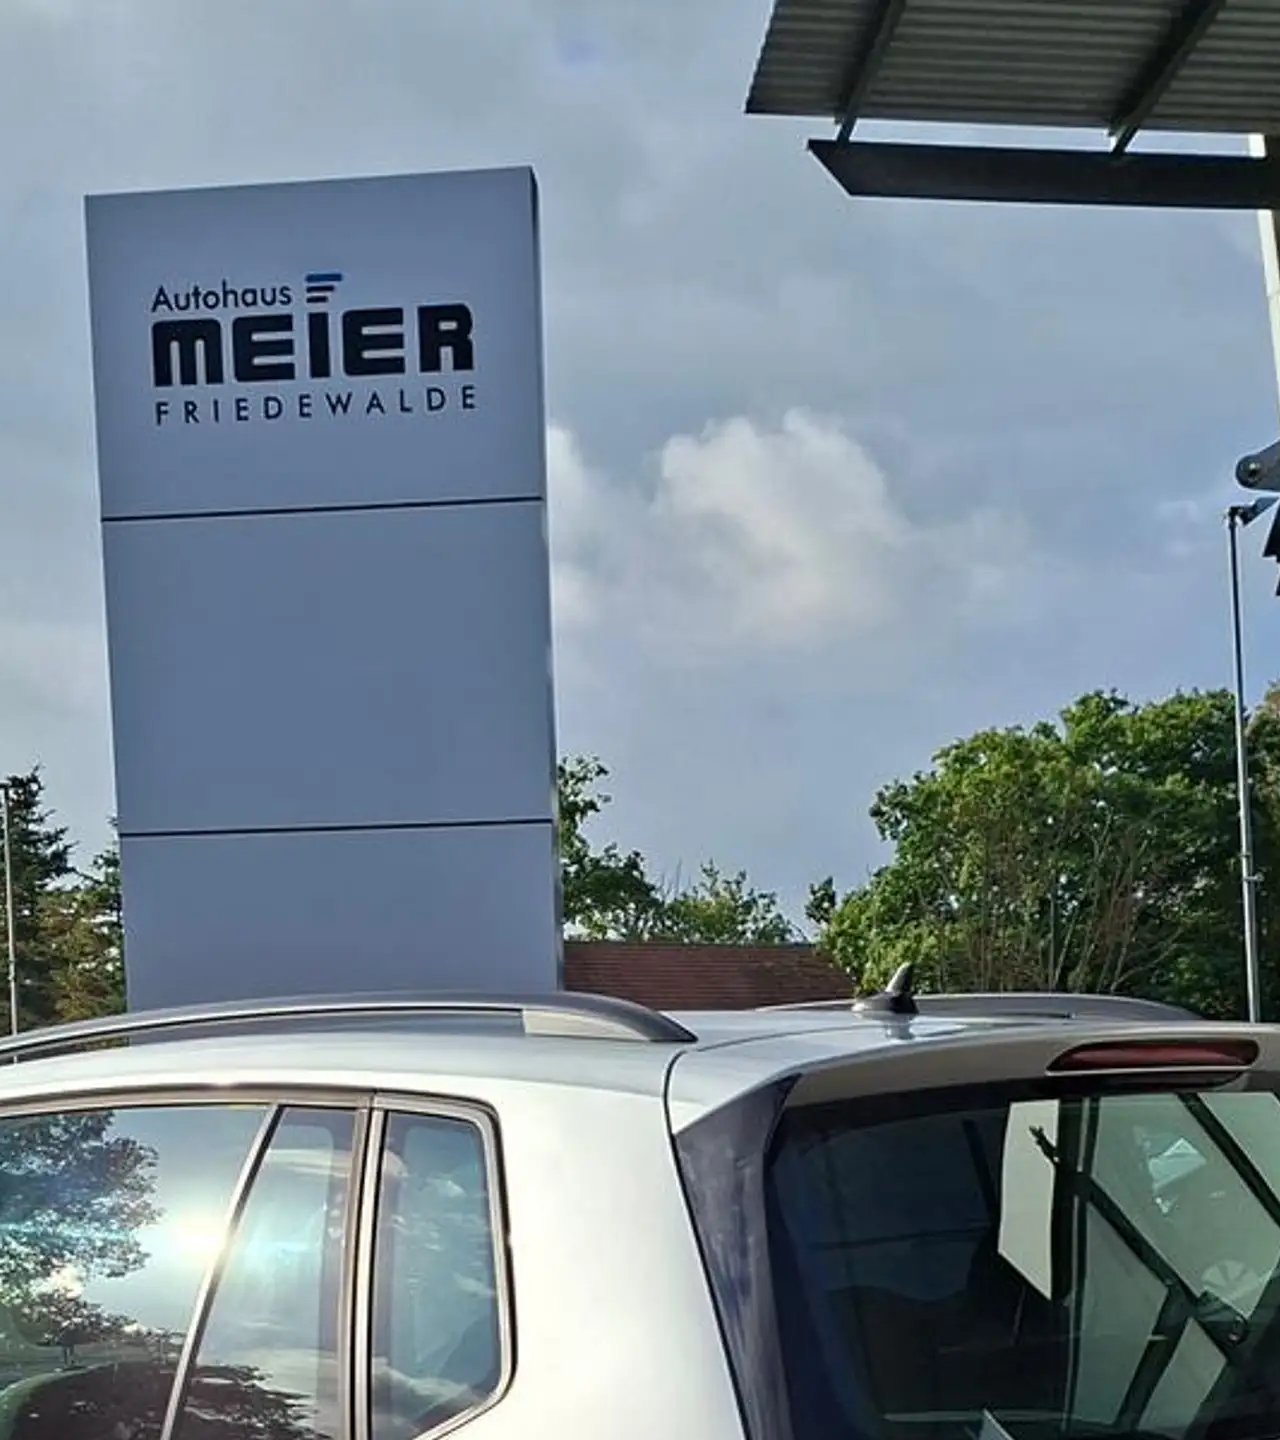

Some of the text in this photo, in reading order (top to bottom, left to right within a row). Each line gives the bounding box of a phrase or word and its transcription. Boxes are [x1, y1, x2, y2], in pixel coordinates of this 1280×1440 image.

[151, 279, 292, 312] Autohaus
[151, 302, 474, 388] MEIER
[155, 385, 477, 426] FRIEDEWALDE
